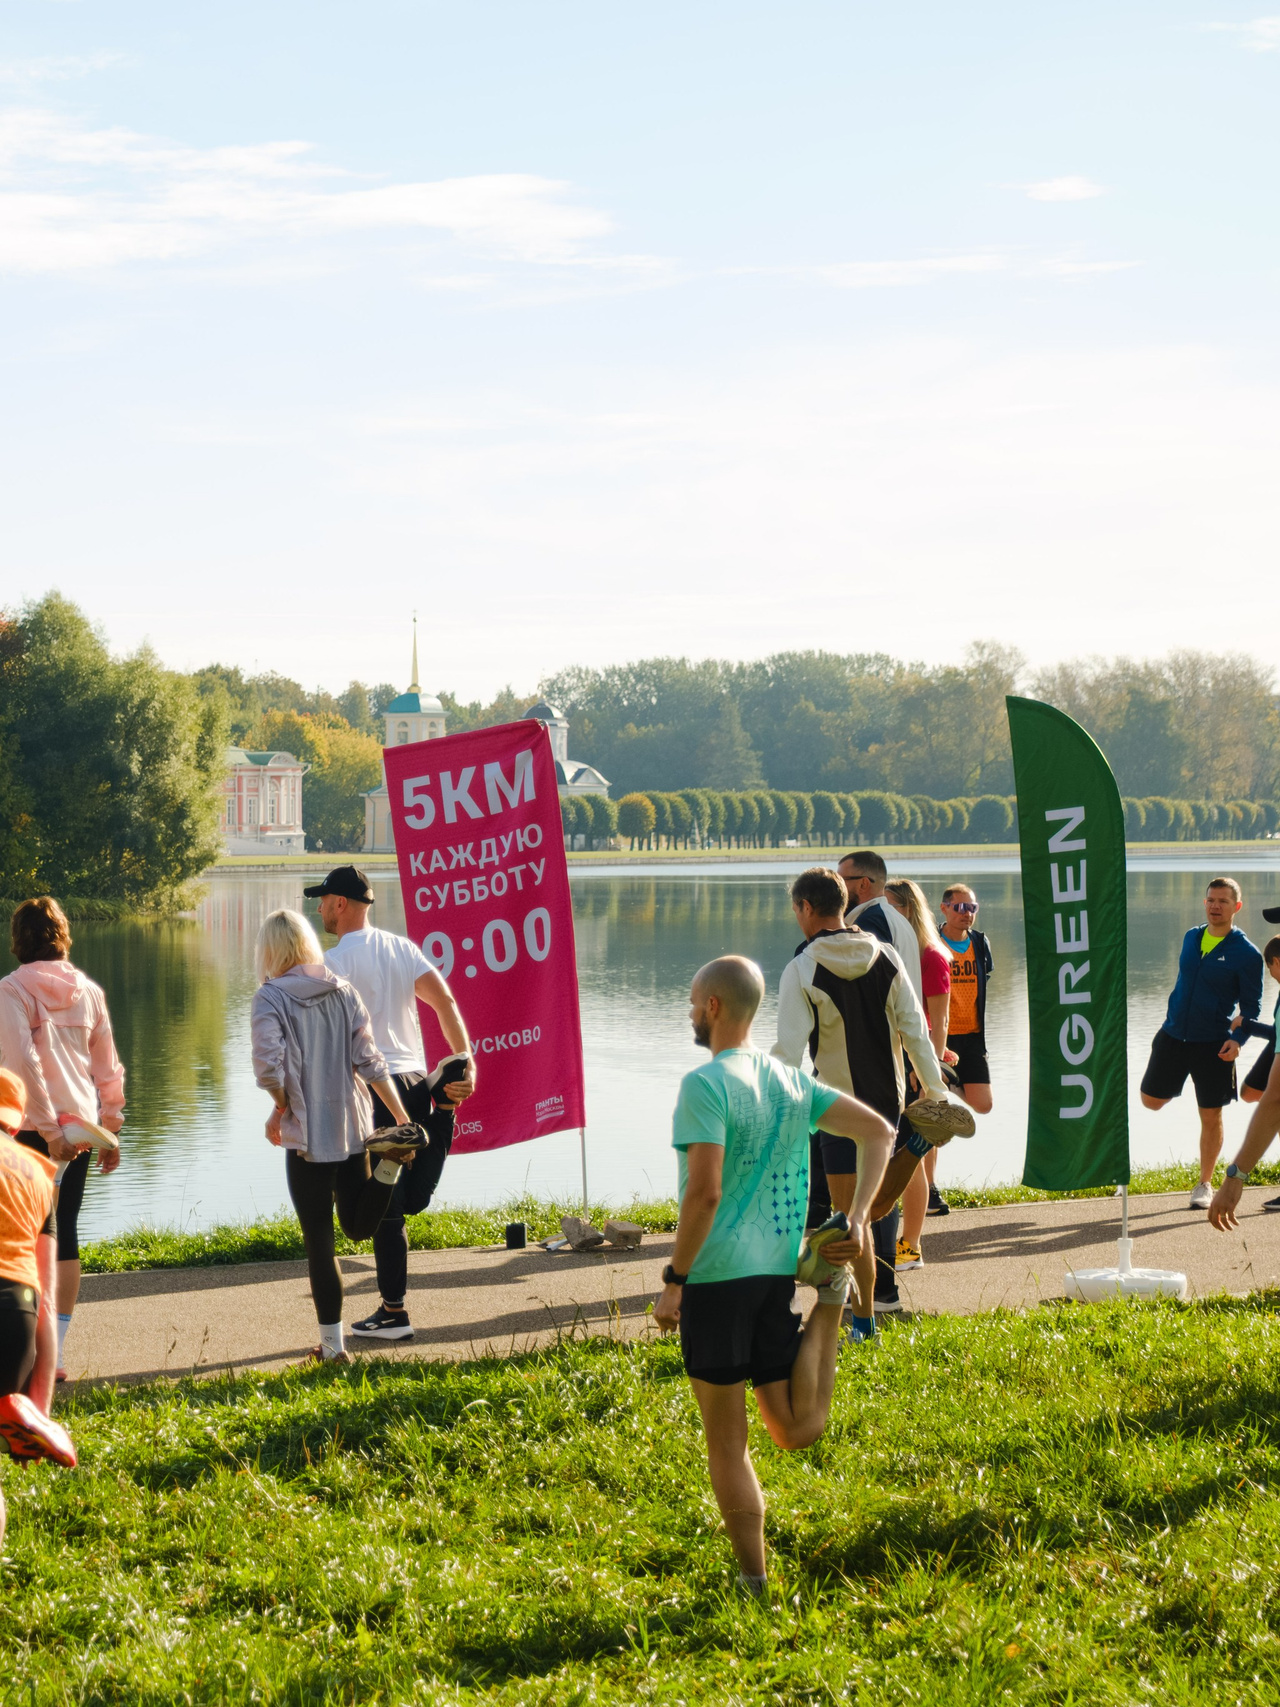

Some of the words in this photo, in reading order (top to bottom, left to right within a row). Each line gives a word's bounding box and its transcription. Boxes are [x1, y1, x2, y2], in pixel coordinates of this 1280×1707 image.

[409, 823, 543, 877] КАЖДУЮ
[415, 857, 546, 912] СУББОТУ
[422, 907, 551, 981] 9:00
[949, 960, 977, 976] 5:00
[1045, 805, 1095, 1119] UGREEN
[469, 1025, 541, 1056] УСКОВО
[535, 1095, 564, 1111] ГРАНТЫ
